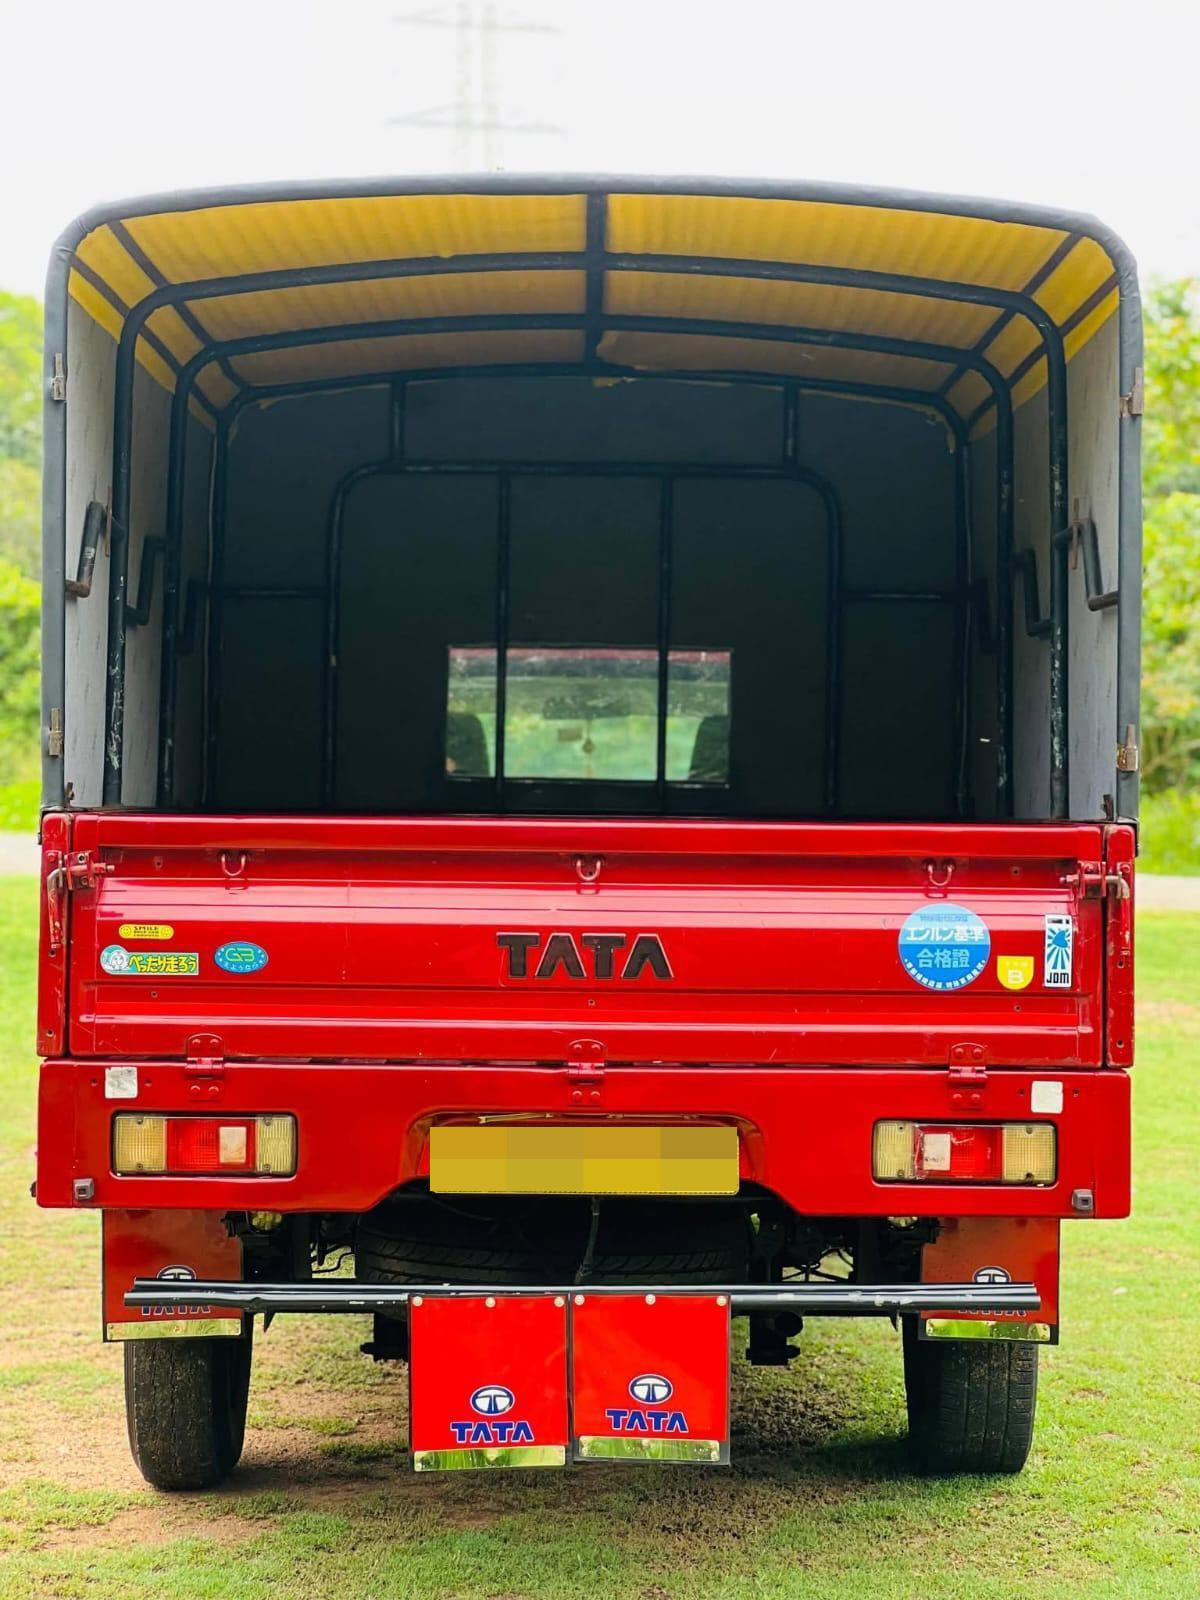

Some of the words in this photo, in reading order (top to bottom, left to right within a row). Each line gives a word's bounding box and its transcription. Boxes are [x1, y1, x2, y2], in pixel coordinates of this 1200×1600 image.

[496, 932, 675, 980] TATA
[1046, 972, 1070, 984] JDM
[450, 1420, 535, 1444] TATA
[606, 1409, 690, 1433] TATA
